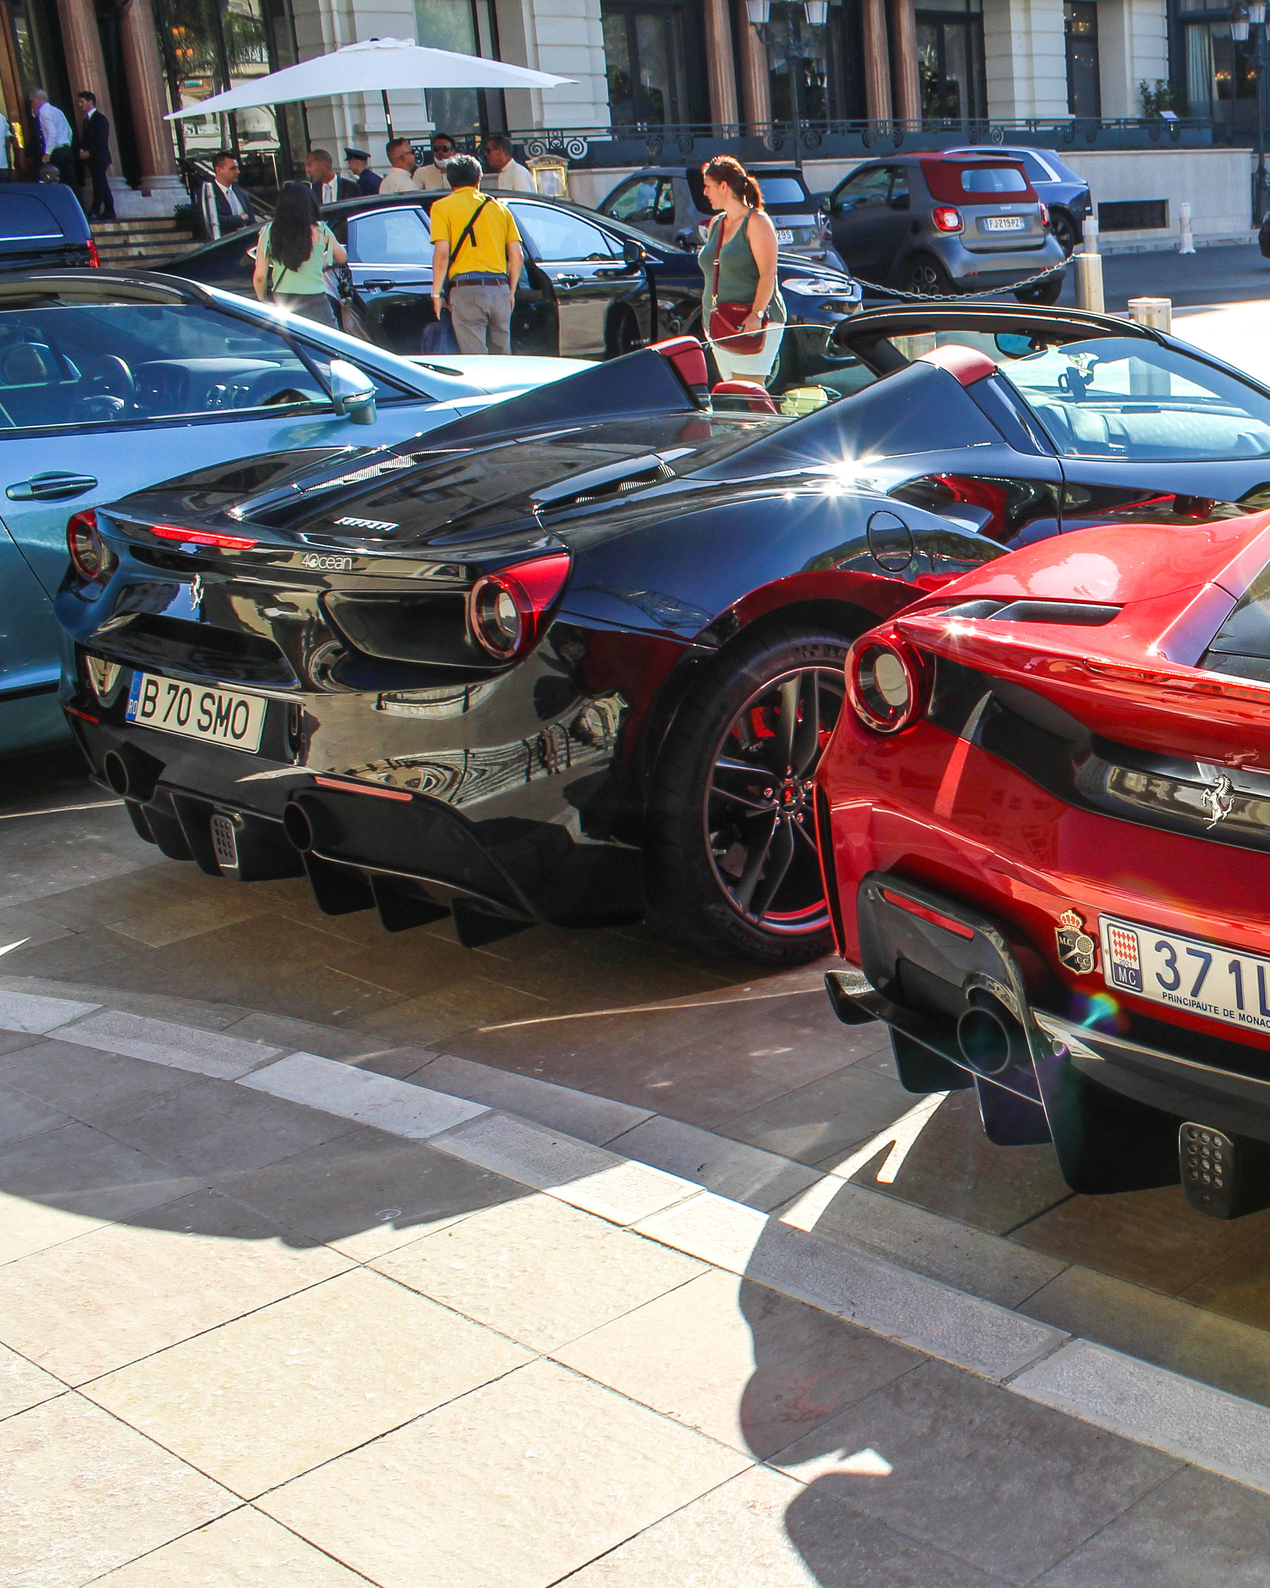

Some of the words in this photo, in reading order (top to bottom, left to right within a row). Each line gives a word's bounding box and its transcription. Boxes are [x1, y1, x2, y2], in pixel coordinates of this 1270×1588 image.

[127, 698, 138, 715] RO
[163, 683, 193, 727] 70
[197, 691, 250, 740] SMO
[1118, 958, 1134, 967] 2021
[1118, 966, 1138, 986] MC
[1162, 991, 1220, 1015] PRINCIPAUTE
[1222, 1008, 1236, 1019] DE
